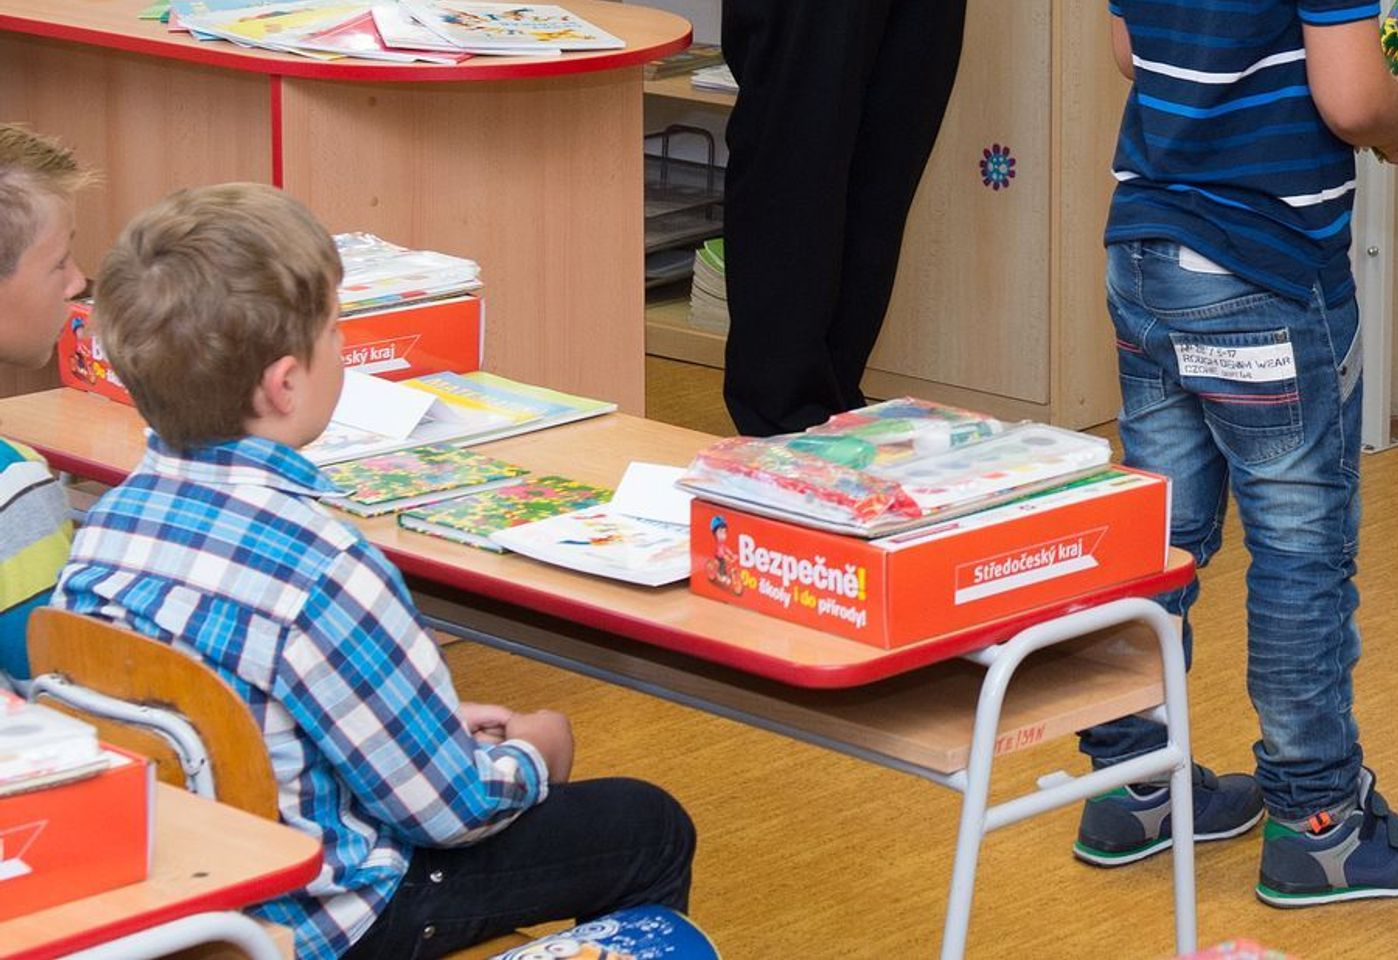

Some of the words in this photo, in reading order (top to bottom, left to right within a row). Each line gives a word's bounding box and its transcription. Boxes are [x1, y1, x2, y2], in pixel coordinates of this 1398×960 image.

[369, 343, 396, 362] kraj
[738, 533, 867, 600] Bezpečně!
[973, 545, 1057, 585] Středočeský
[1058, 537, 1083, 560] kraj
[758, 577, 792, 609] školy
[799, 589, 817, 609] do
[817, 597, 868, 629] přírody!
